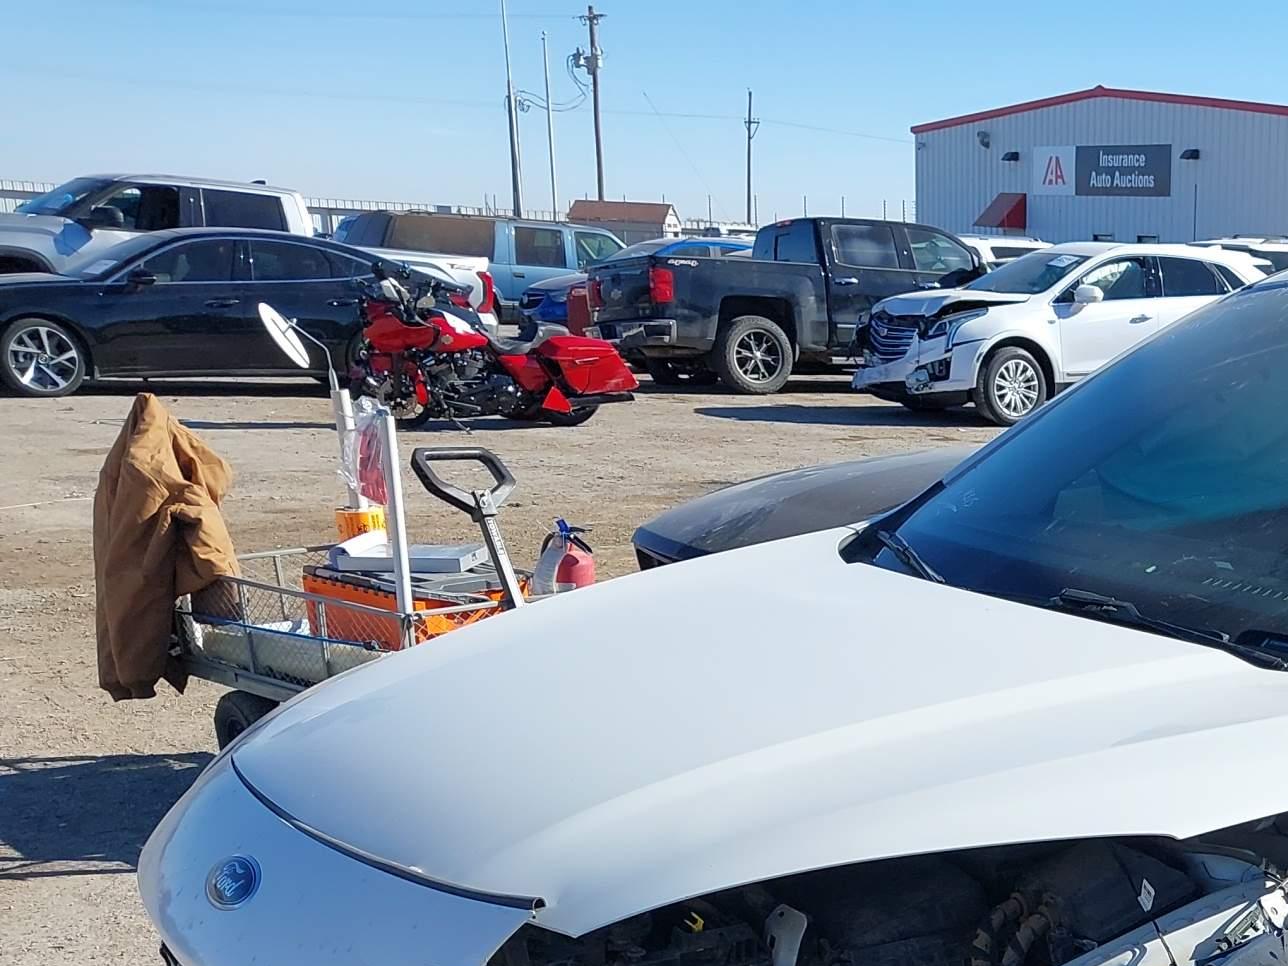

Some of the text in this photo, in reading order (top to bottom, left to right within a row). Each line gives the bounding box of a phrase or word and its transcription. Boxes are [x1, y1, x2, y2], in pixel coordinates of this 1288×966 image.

[1099, 150, 1146, 167] Insurance
[1089, 170, 1155, 188] Auto Auctions
